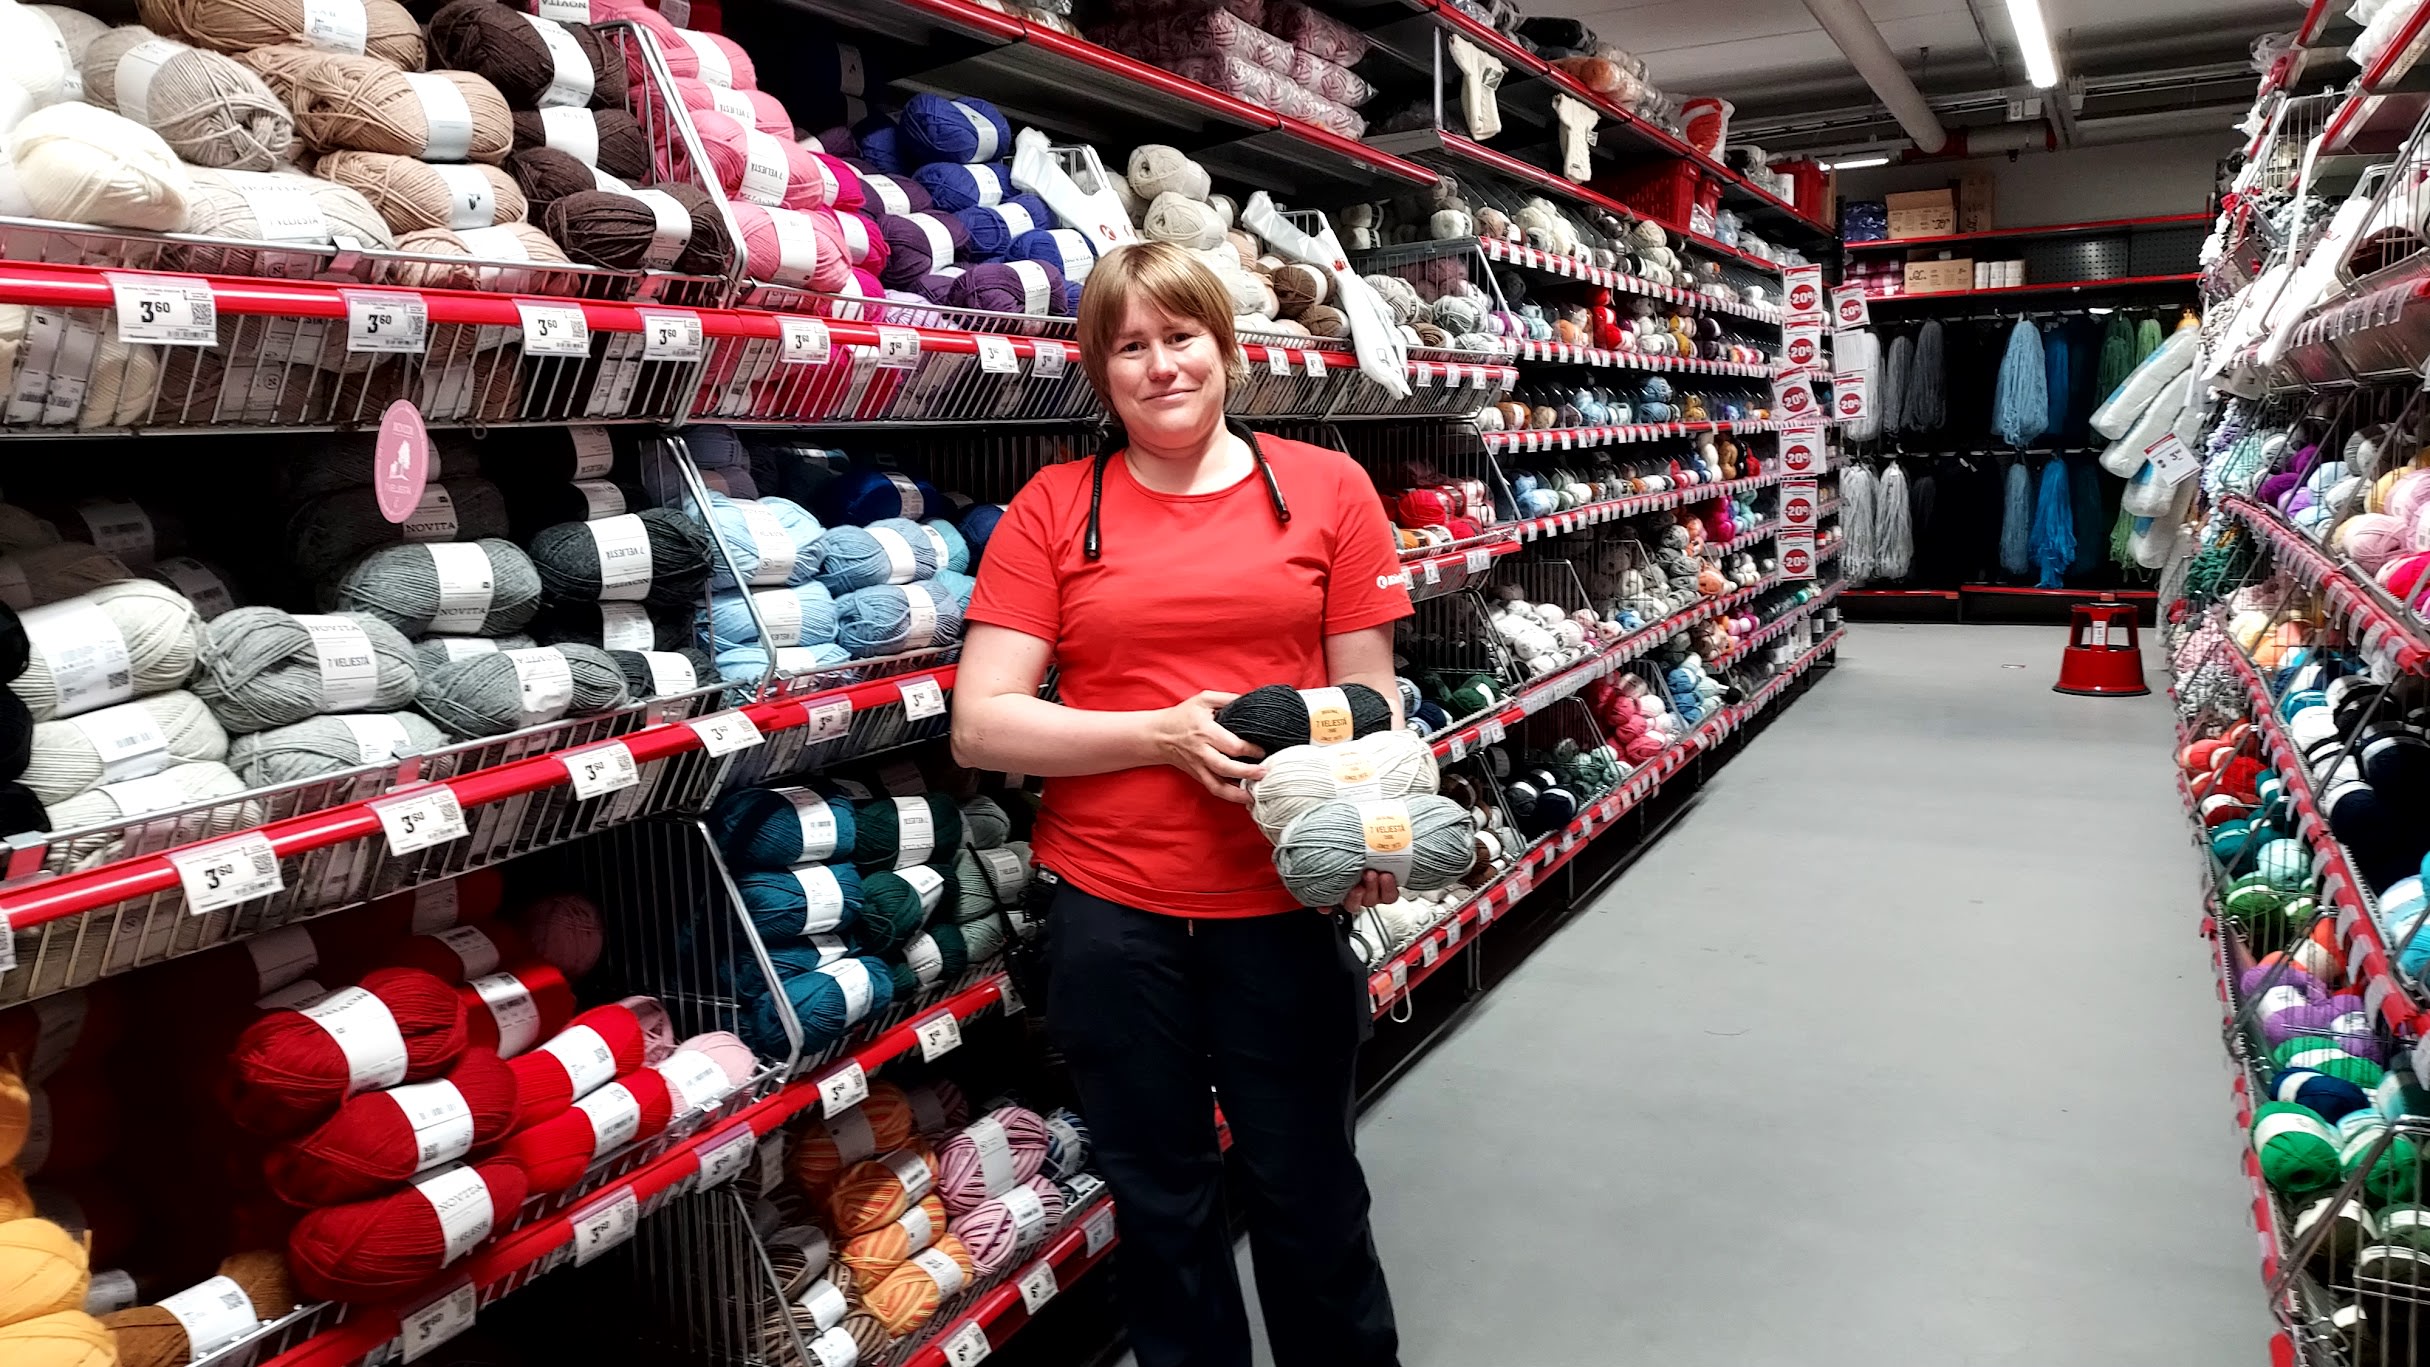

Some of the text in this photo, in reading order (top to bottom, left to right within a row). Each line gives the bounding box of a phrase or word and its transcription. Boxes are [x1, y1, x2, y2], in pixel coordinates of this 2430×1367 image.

[1789, 291, 1819, 305] -20%
[1839, 304, 1864, 318] -20%
[1787, 345, 1817, 359] -20%
[1782, 391, 1812, 408] -20%
[1839, 399, 1864, 411] -20%
[1784, 452, 1815, 465] -20%
[1783, 504, 1814, 517] -20%
[405, 520, 456, 533] NOVITA
[1782, 556, 1812, 568] -20%
[439, 605, 487, 617] NOVITA
[308, 624, 361, 633] NOVITA
